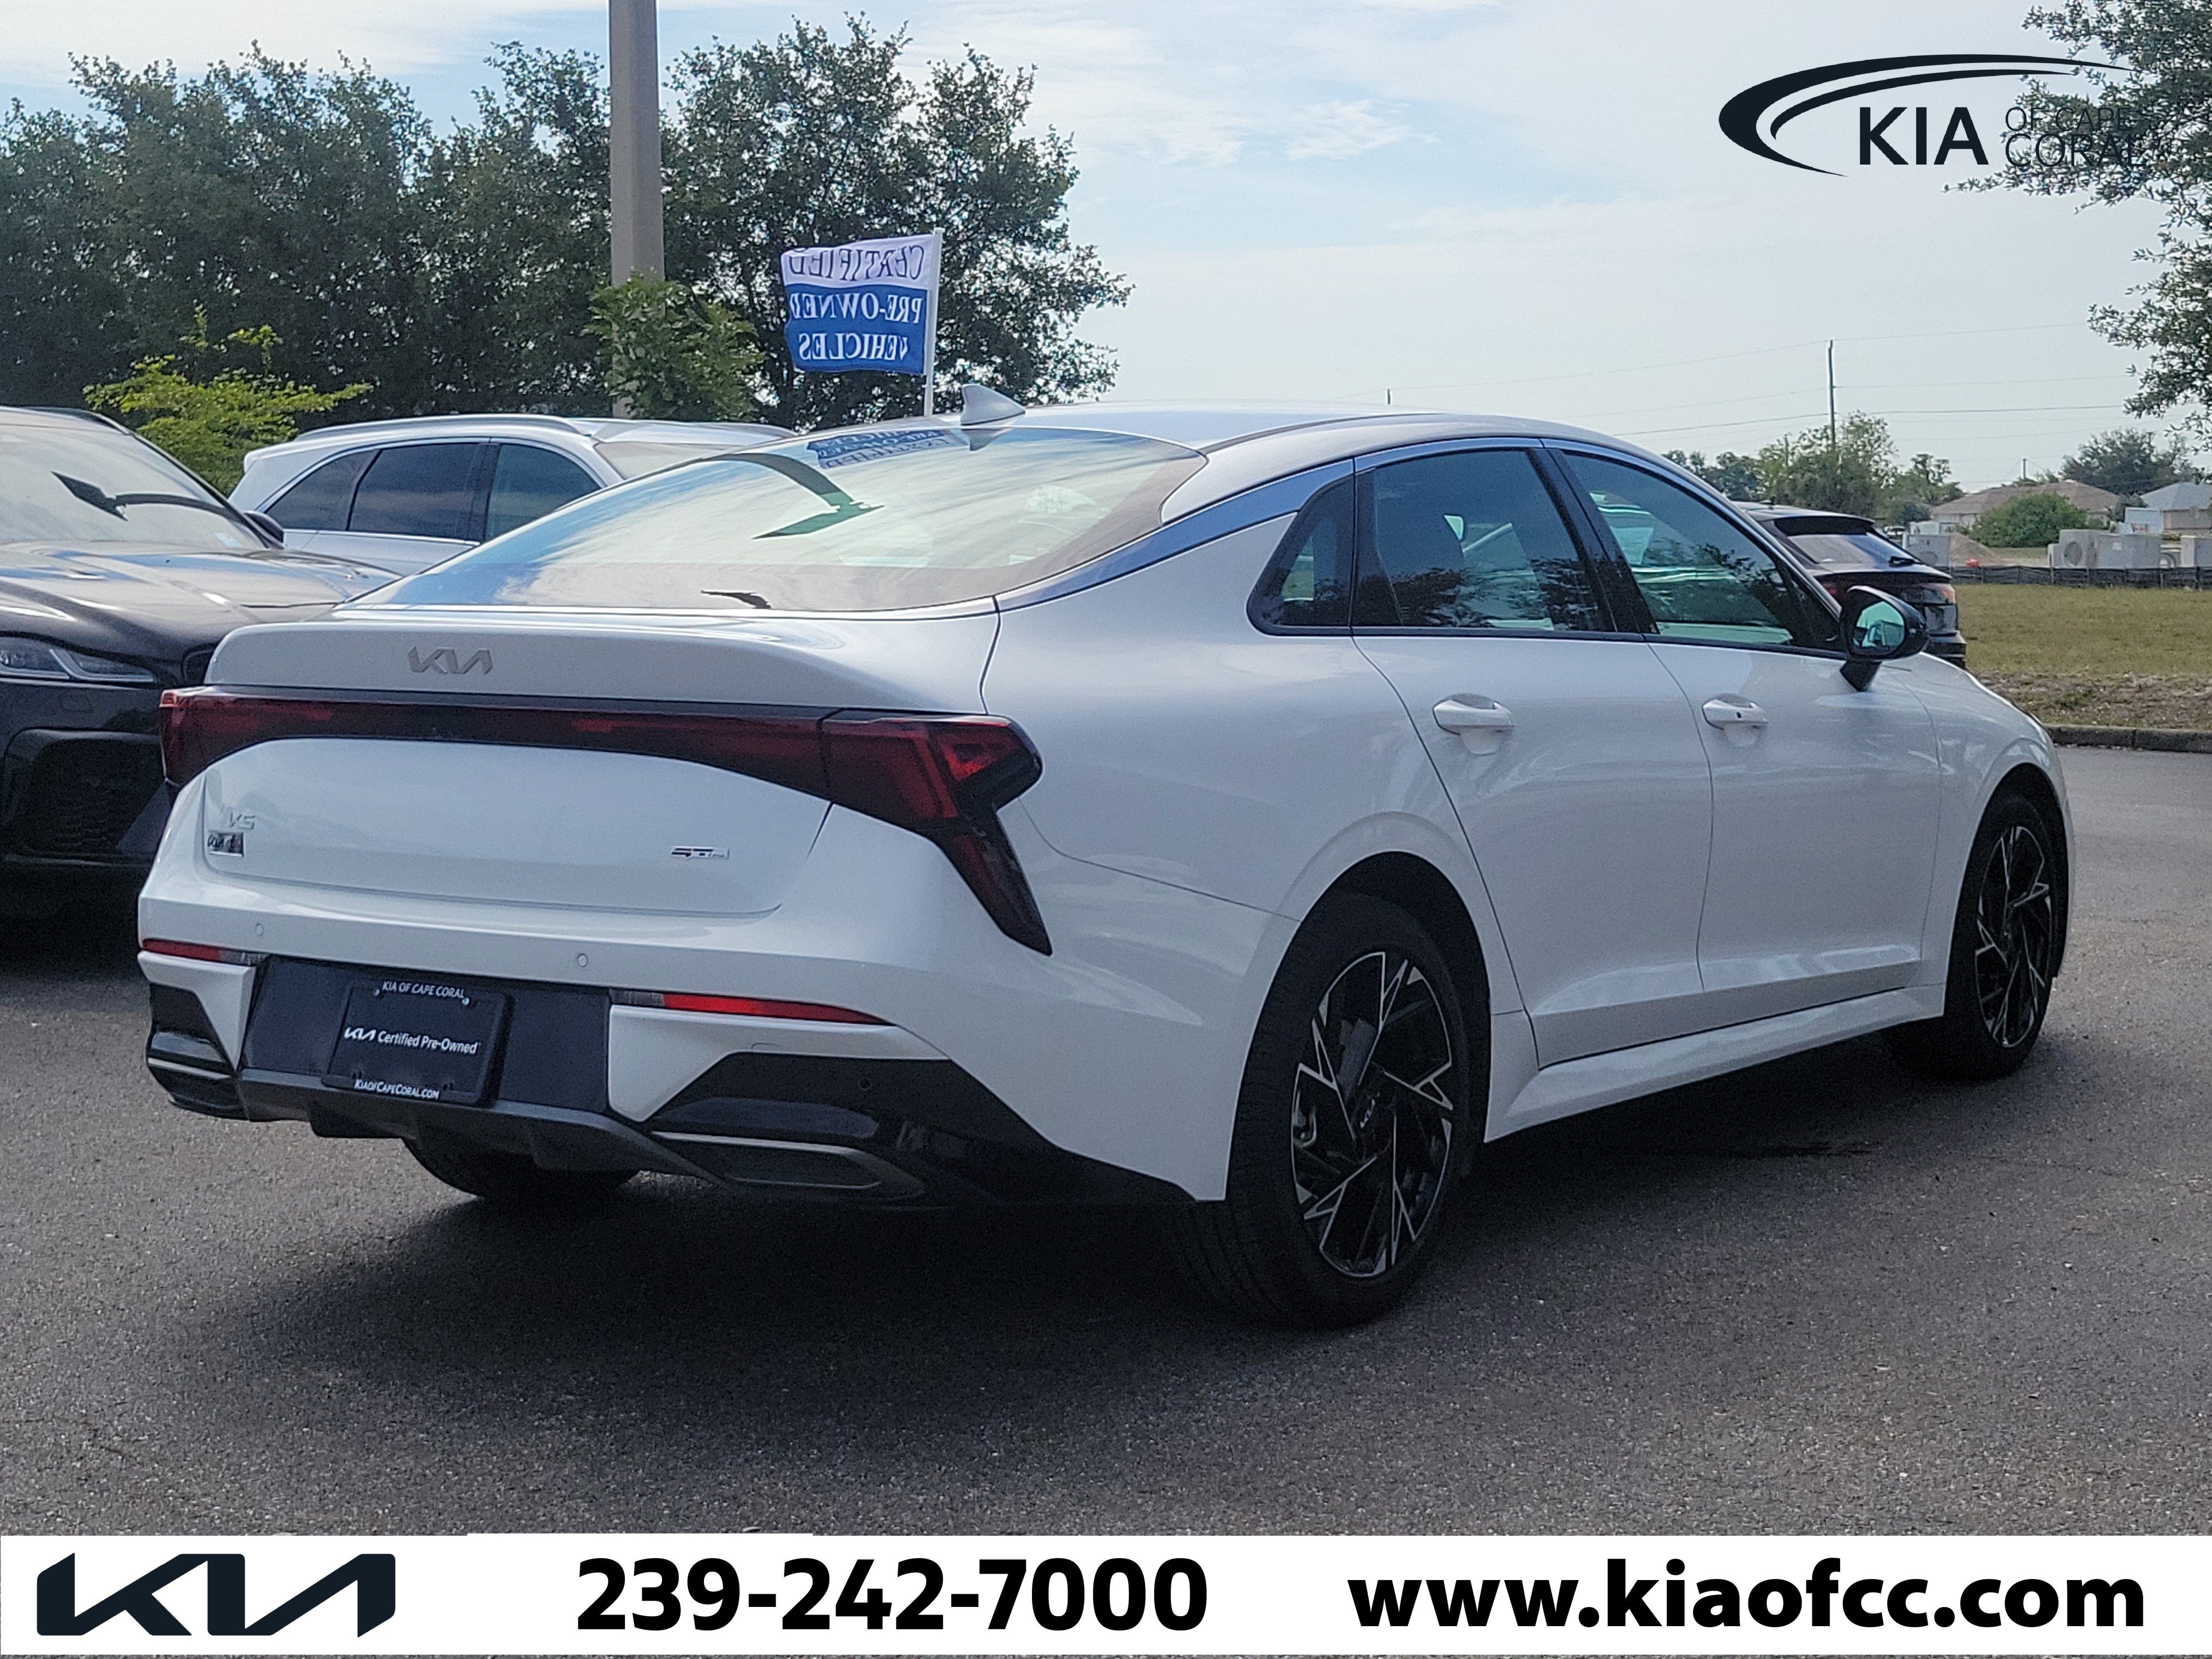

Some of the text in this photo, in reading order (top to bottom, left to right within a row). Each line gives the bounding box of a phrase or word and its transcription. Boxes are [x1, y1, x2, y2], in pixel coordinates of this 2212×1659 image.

[407, 646, 494, 675] KIA
[382, 980, 465, 998] KIA OF CAPE CORAL
[377, 1030, 421, 1047] Certified
[421, 1035, 478, 1054] Pre-Owned
